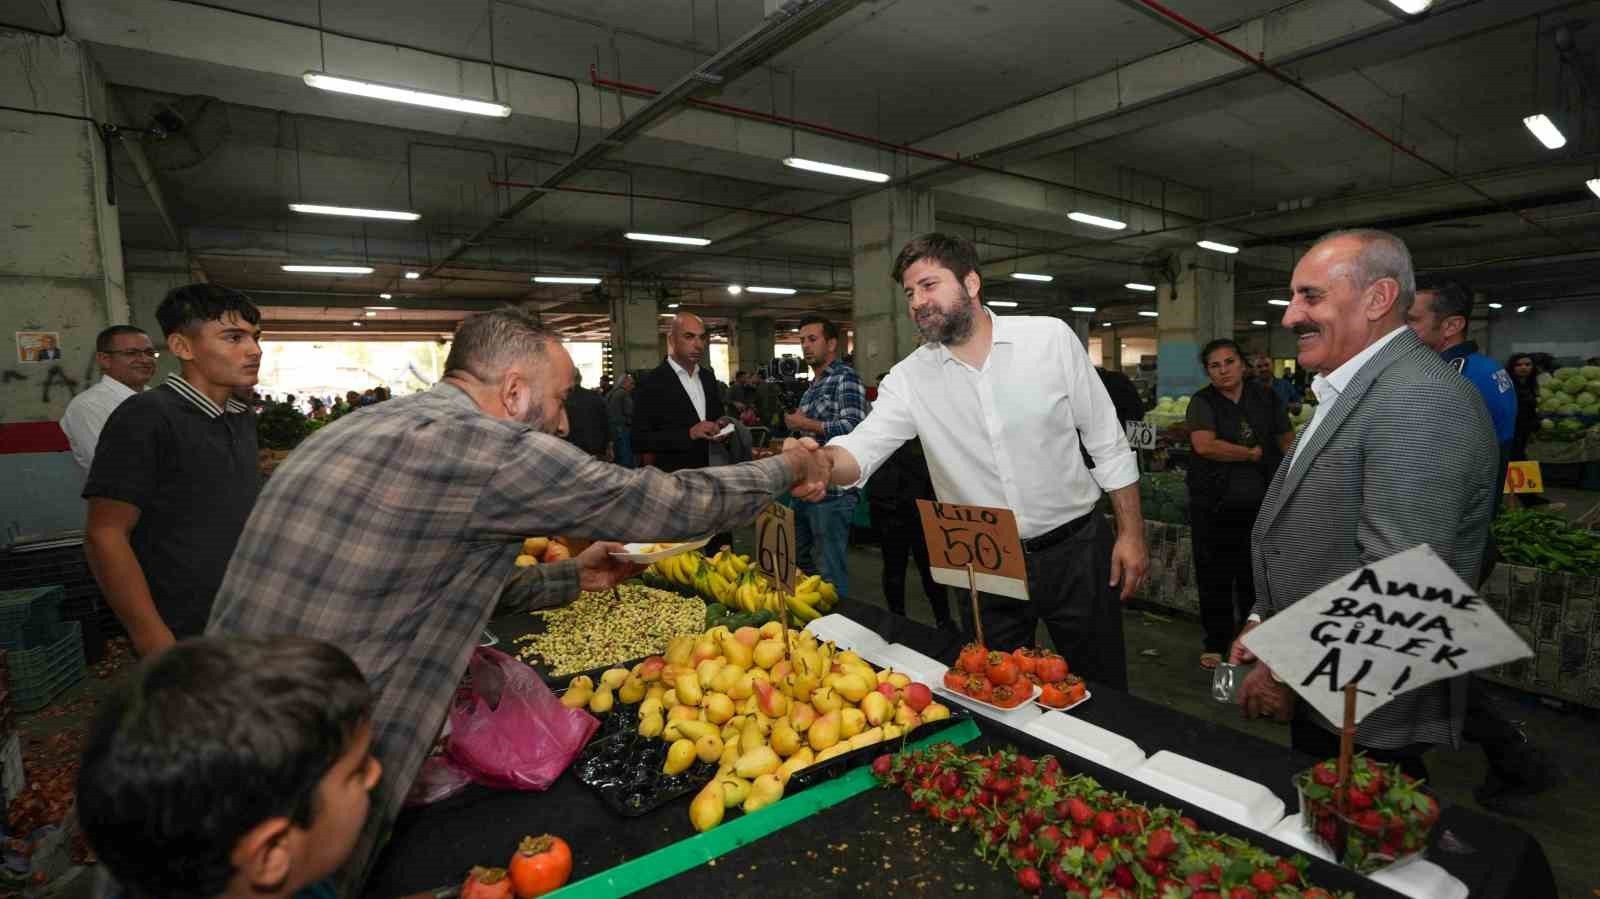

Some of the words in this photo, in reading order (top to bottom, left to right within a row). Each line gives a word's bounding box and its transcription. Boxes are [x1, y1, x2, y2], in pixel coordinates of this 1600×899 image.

[759, 519, 789, 583] 60
[940, 526, 1002, 570] 50
[1320, 597, 1455, 641] BANA
[1301, 647, 1412, 697] AL!
